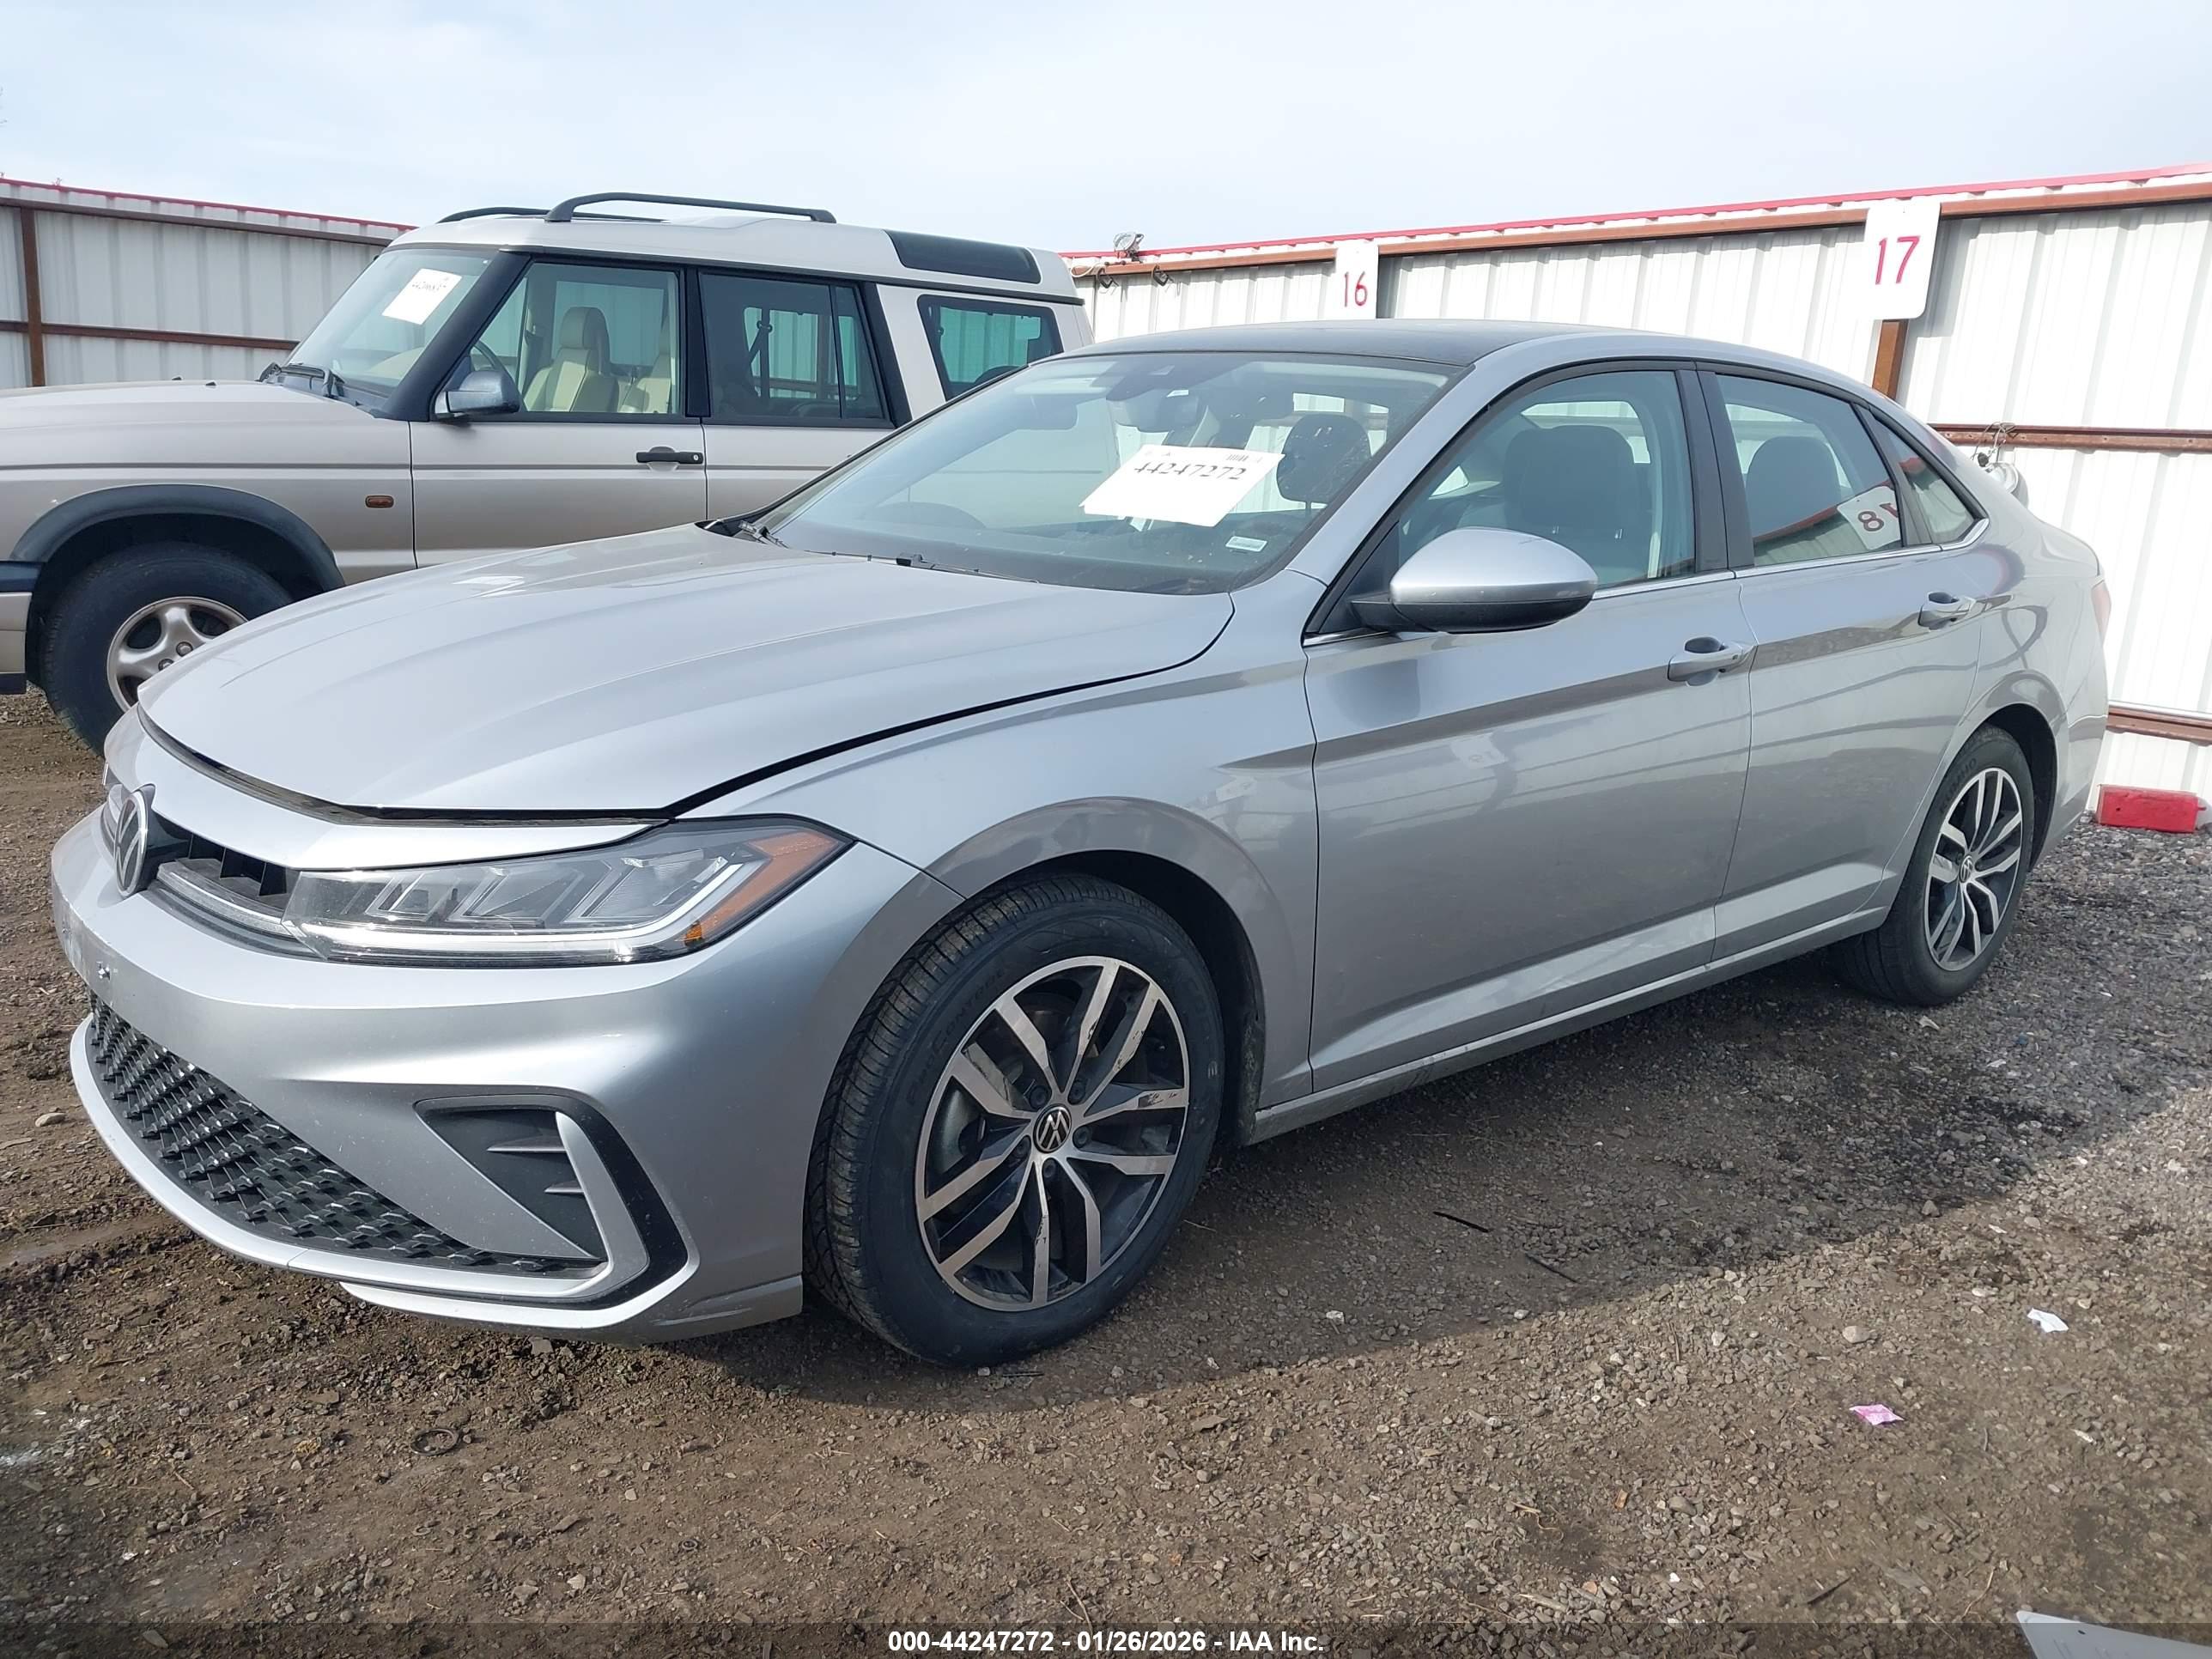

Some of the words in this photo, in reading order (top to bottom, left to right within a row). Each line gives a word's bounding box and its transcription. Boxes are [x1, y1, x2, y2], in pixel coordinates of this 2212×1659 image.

[1875, 235, 1921, 285] 17
[1344, 270, 1368, 307] 16
[1133, 461, 1247, 480] 44247272
